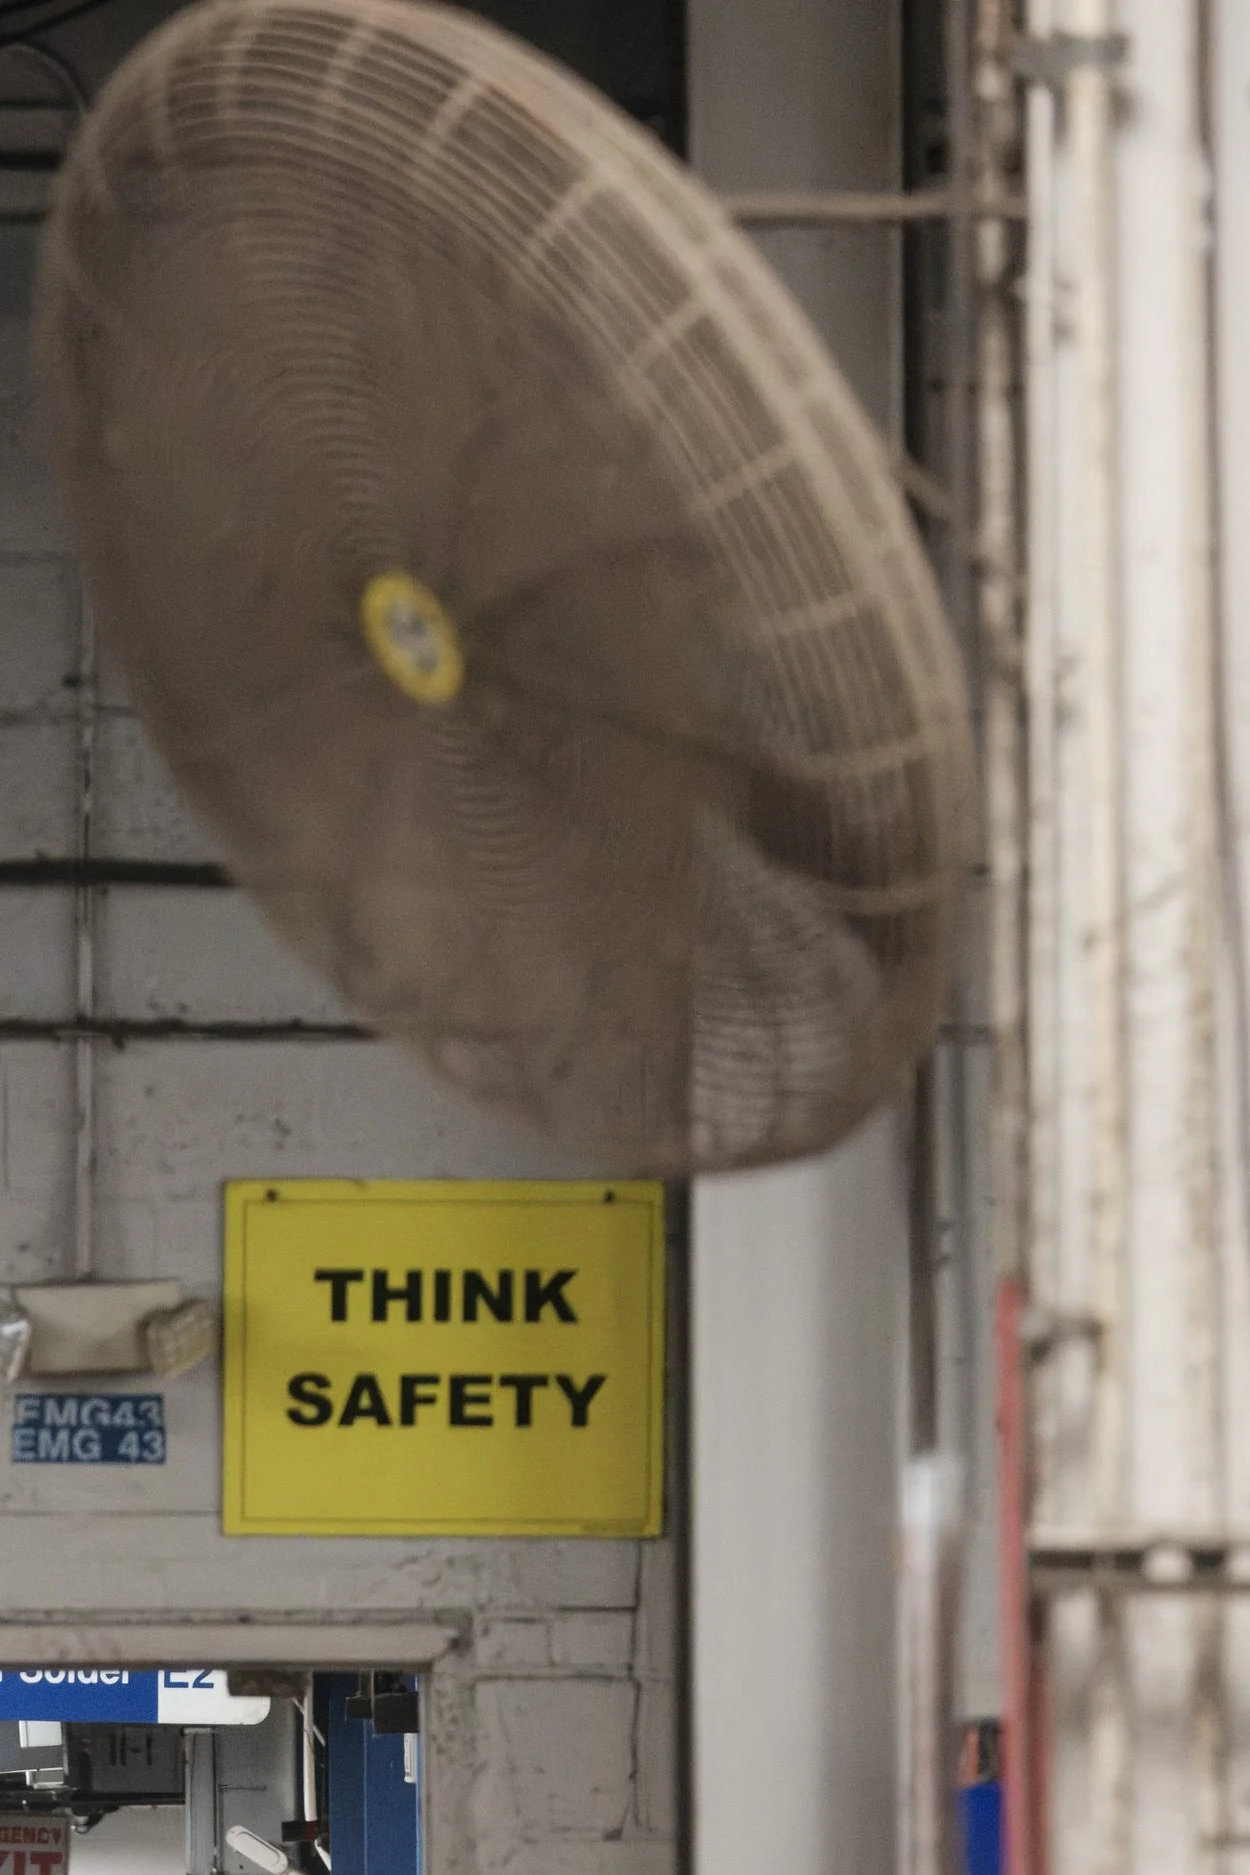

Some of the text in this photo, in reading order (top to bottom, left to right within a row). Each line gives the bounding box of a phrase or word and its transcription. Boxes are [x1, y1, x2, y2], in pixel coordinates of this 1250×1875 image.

[313, 1268, 579, 1324] THINK
[286, 1371, 607, 1428] SAFETY
[13, 1427, 164, 1462] EMG 43
[163, 1669, 214, 1689] E2
